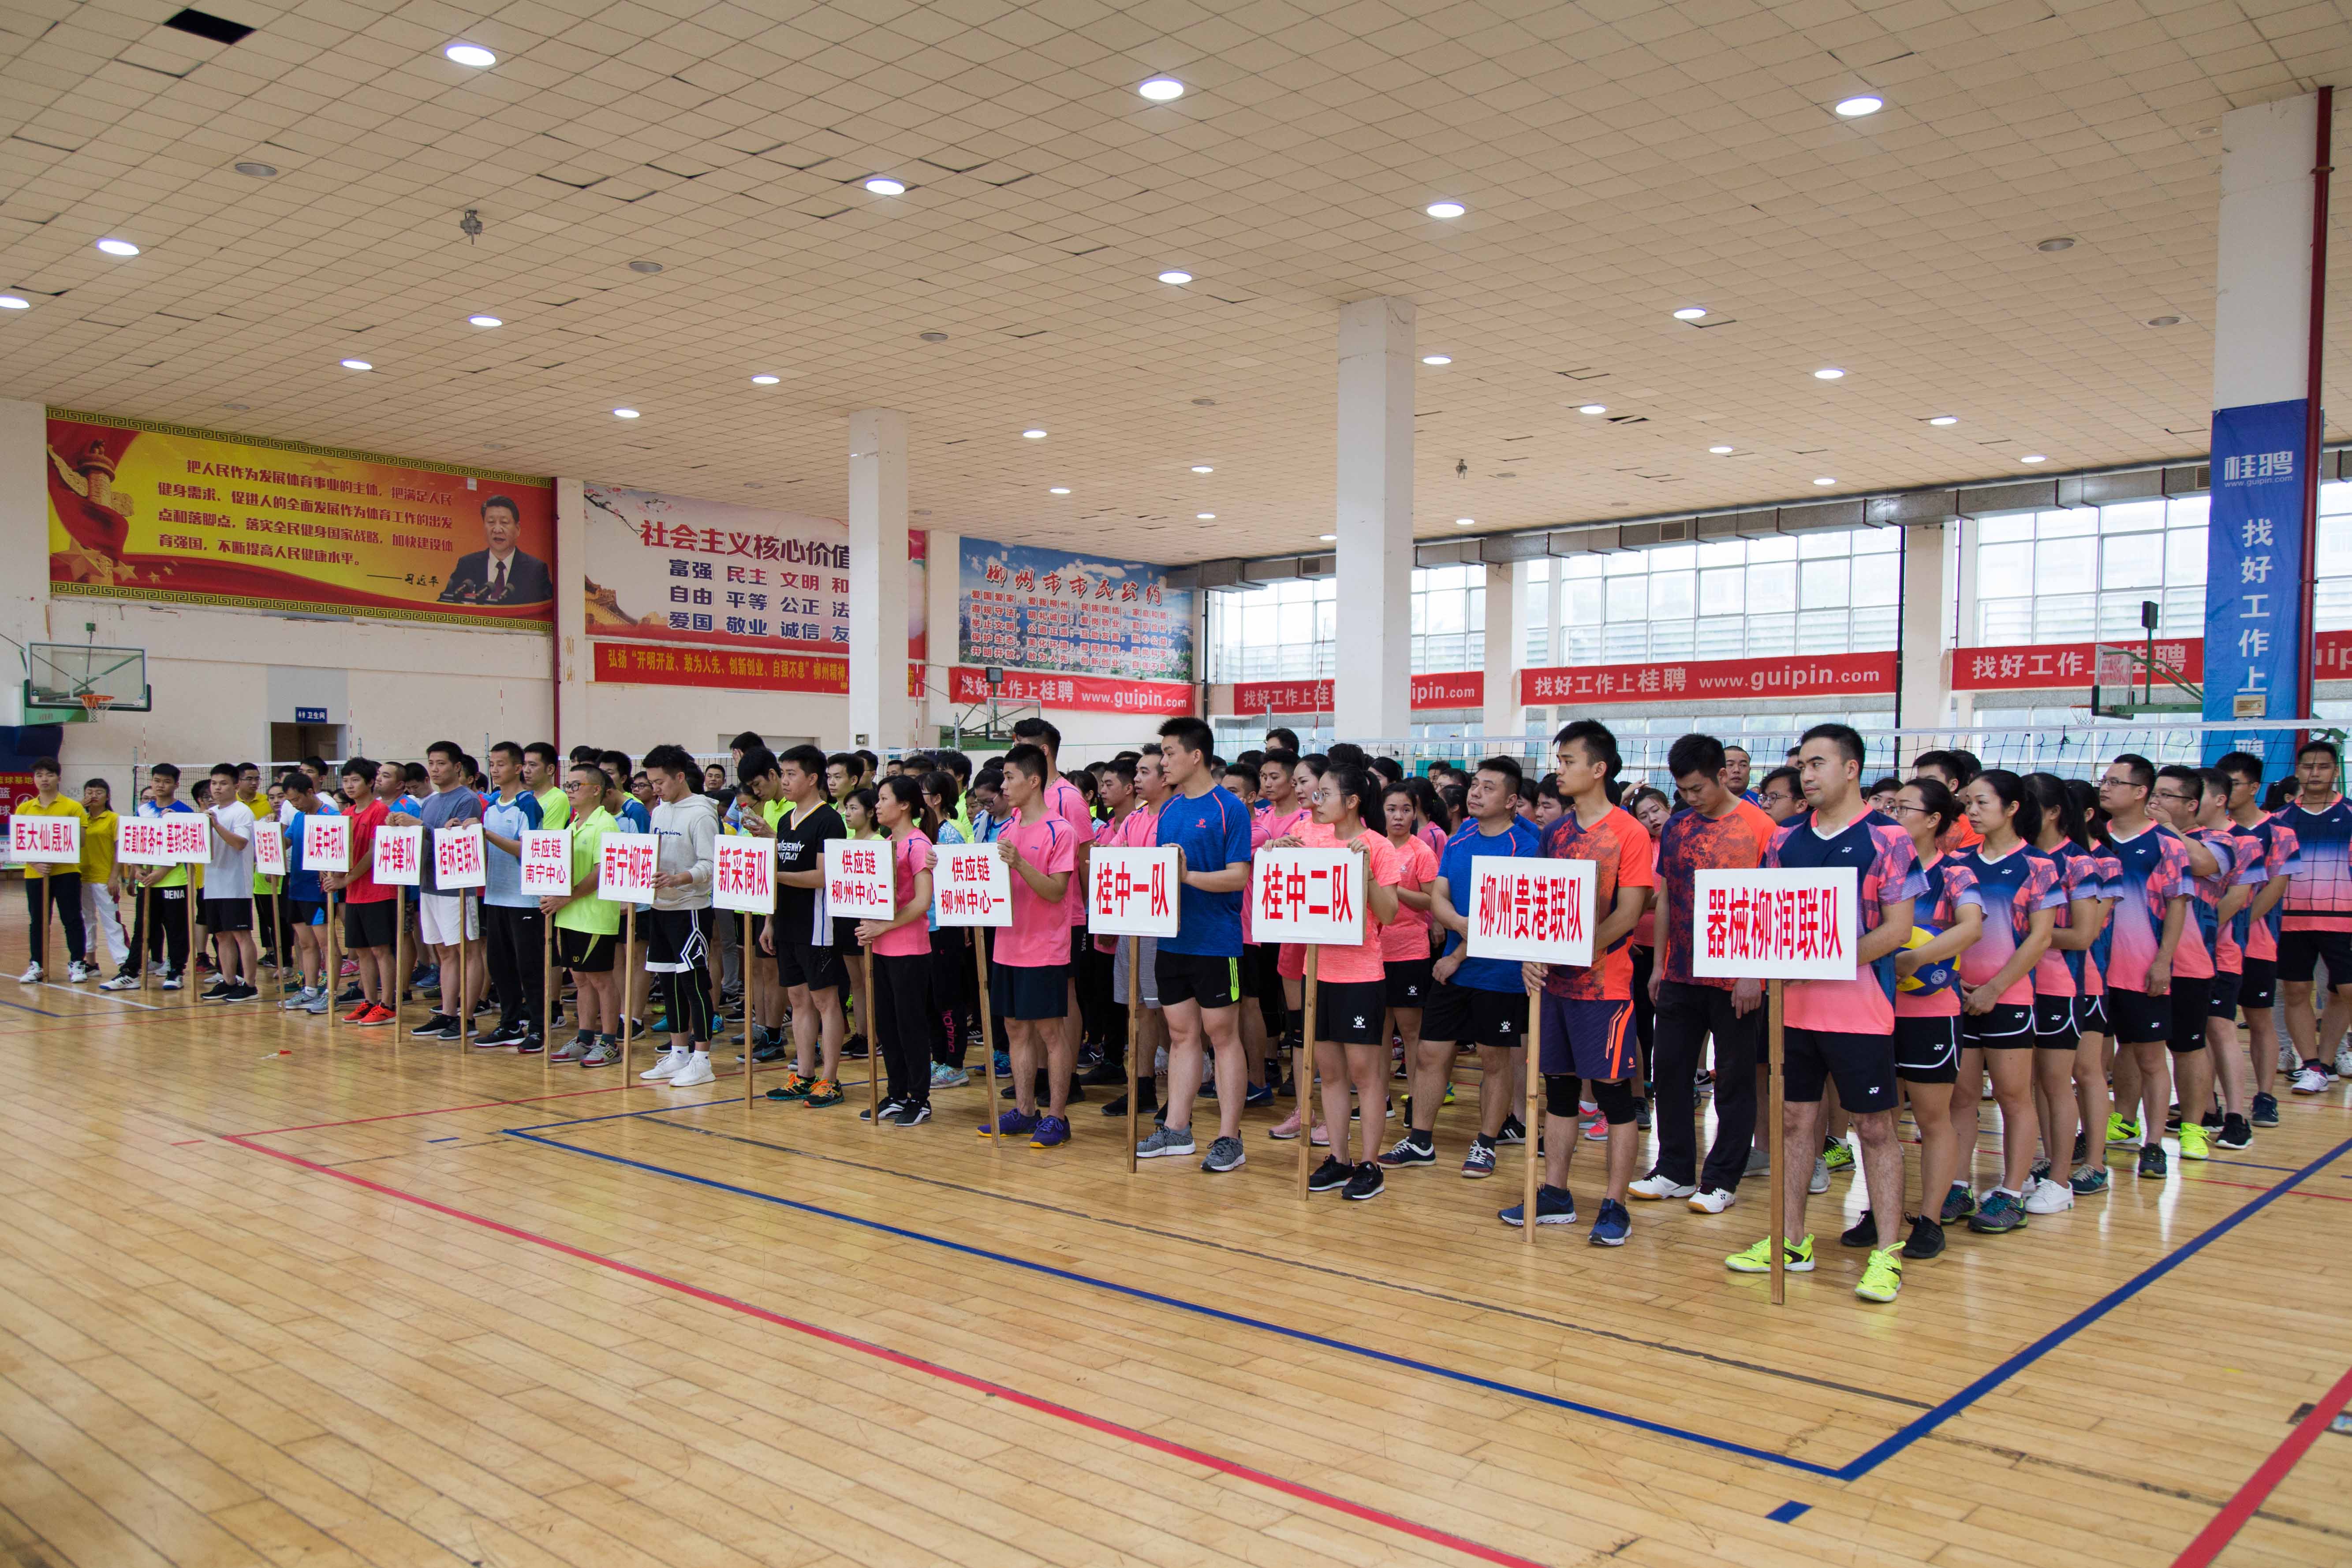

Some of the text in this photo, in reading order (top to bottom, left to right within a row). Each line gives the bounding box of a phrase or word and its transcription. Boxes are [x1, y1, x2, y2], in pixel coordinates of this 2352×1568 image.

[2224, 451, 2293, 480] 桂聘
[2224, 476, 2293, 487] www.guipin.com
[669, 559, 713, 580] 富强
[727, 565, 768, 586] 民主
[780, 572, 819, 591] 文明
[986, 564, 1161, 605] 柳州市市民公约
[670, 586, 713, 606] 自由
[726, 591, 768, 611] 平等
[780, 596, 820, 616] 公正
[669, 611, 713, 631] 爱国
[726, 616, 768, 636] 敬业
[780, 621, 820, 640] 诚信
[1535, 664, 1880, 697] 找好工作上桂聘 www.guipin.com
[1082, 688, 1187, 709] www.guipin.com
[1244, 685, 1335, 708] 找好工作上桂
[16, 822, 74, 853] 医大仙晟队
[530, 838, 561, 858] 供应链
[378, 836, 416, 874] 冲锋队
[439, 834, 481, 875] 桂林百联队
[605, 843, 653, 889] 南宁柳药
[842, 850, 876, 875] 供应链
[952, 855, 990, 883] 供应链
[526, 863, 566, 884] 南宁中心
[718, 845, 769, 896] 新采商队
[831, 879, 889, 905] 柳州中心二
[941, 888, 1005, 915] 柳州中心一
[1096, 861, 1169, 918] 桂中一队
[1262, 862, 1353, 924] 桂中二队
[1478, 872, 1583, 944] 柳州贵港联队
[1707, 886, 1843, 961] 器械柳润联队
